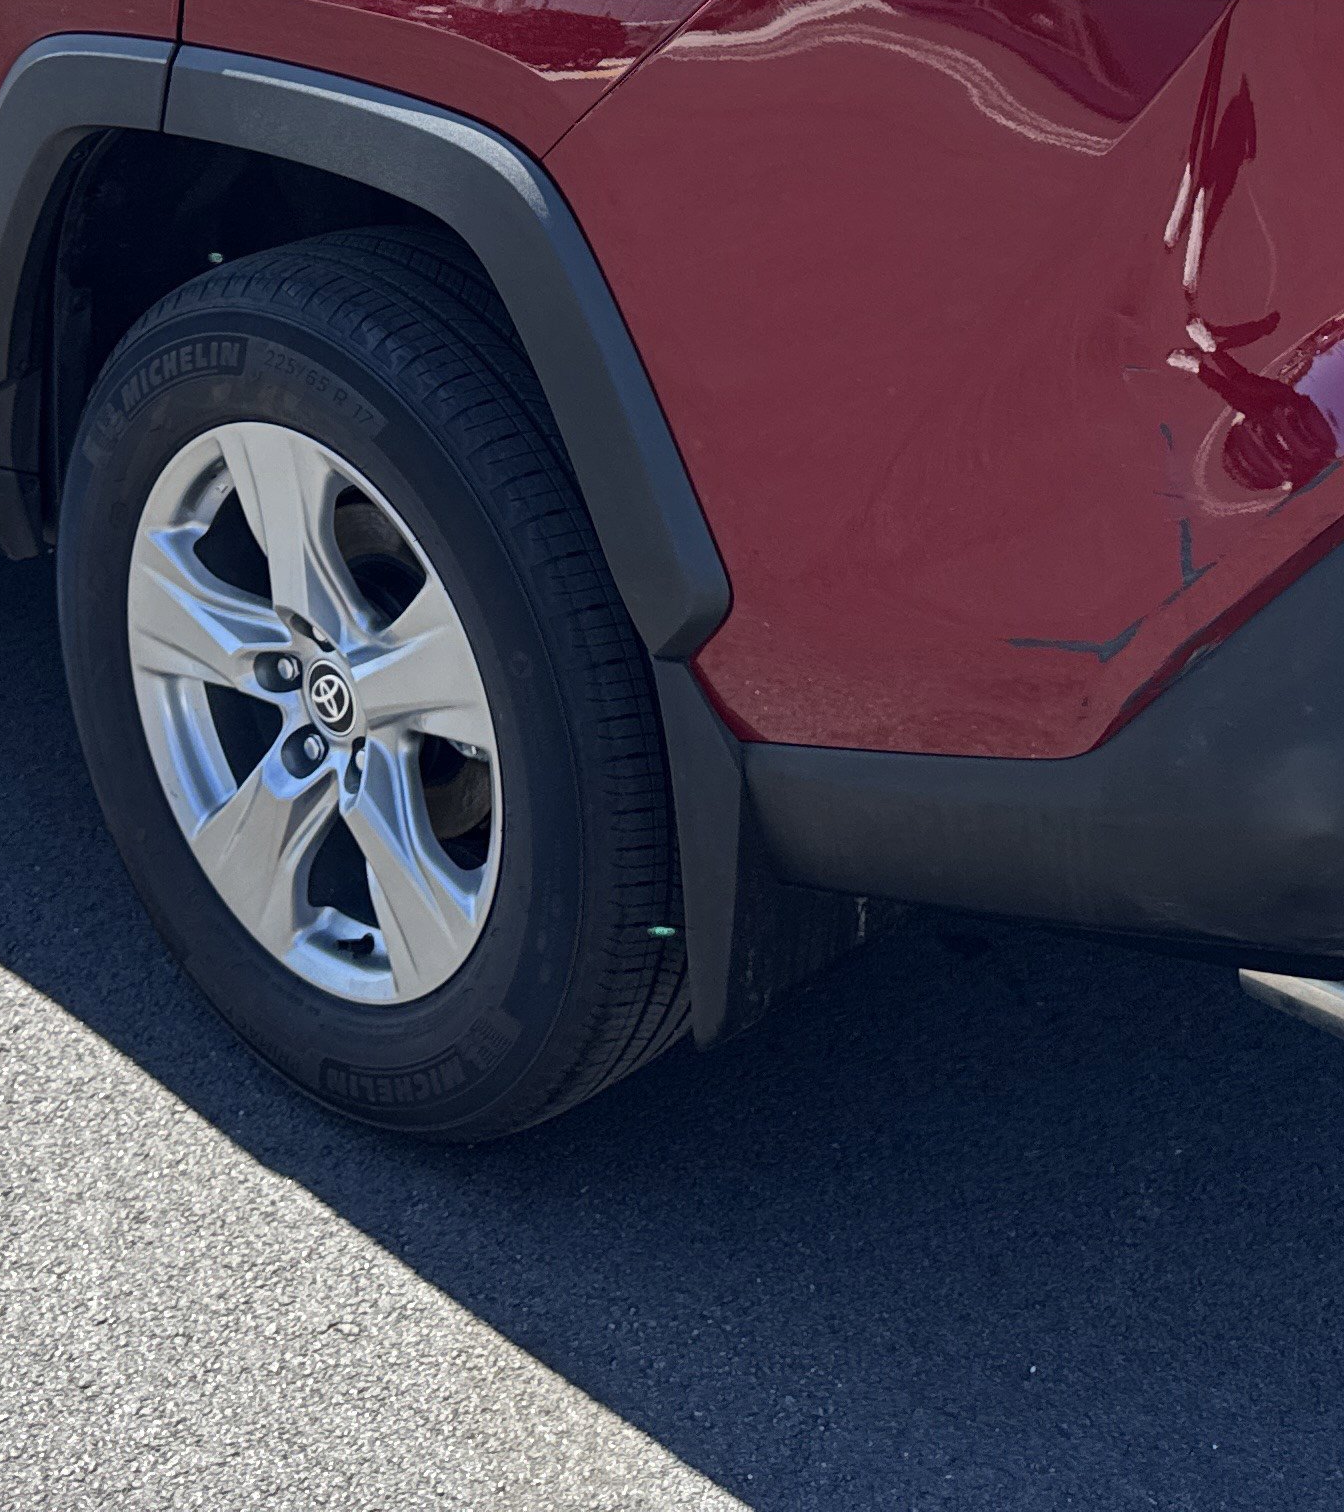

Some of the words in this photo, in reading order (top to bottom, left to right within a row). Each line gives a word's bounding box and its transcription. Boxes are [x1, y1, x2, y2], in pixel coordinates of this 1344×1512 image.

[120, 341, 241, 412] MICHELIN
[263, 349, 330, 393] 225/65
[326, 1055, 467, 1103] MICHELIN
